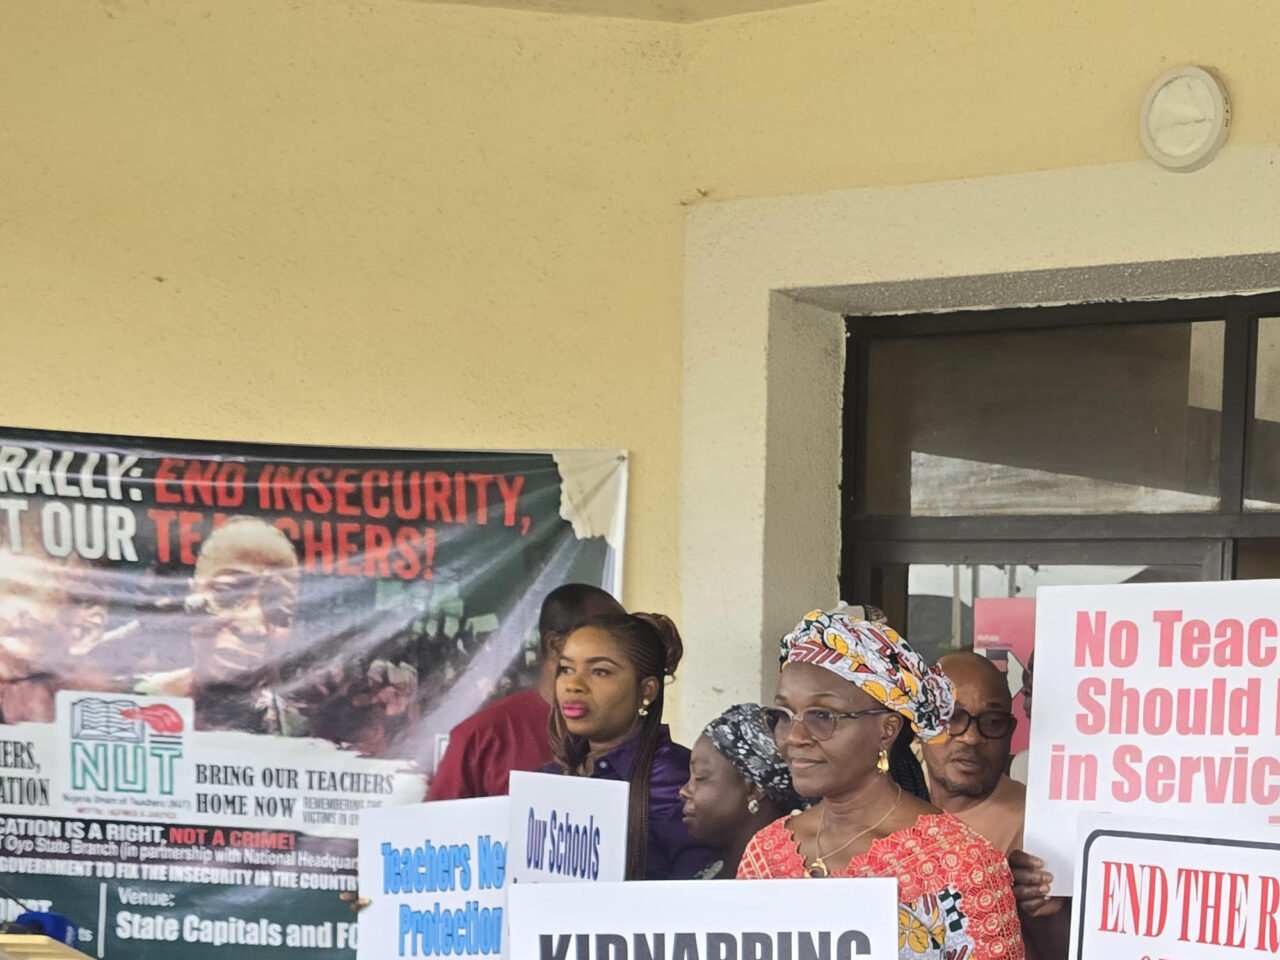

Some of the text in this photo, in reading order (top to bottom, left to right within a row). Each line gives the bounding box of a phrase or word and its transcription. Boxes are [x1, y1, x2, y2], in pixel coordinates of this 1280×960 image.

[0, 446, 531, 536] RALLY: END INSECURITY,
[41, 501, 139, 562] OUR
[148, 508, 436, 580] TEHERS!
[1074, 610, 1139, 668] No
[1076, 677, 1261, 736] Should
[71, 741, 183, 795] NUT
[195, 764, 394, 795] BRING OUR TEACHERS
[1049, 744, 1098, 801] in
[195, 792, 248, 816] HOME
[254, 796, 298, 818] NOW
[4, 835, 34, 855] Oyo
[35, 837, 70, 854] State
[71, 840, 119, 857] Branch
[139, 844, 212, 864] partnership
[215, 847, 242, 863] with
[244, 849, 295, 867] National
[298, 851, 358, 873] Headquar
[64, 821, 86, 839] IS
[87, 823, 103, 840] A
[106, 824, 168, 845] RIGHT,
[169, 827, 206, 845] NOT
[211, 829, 225, 846] A
[229, 830, 295, 850] CRIME!
[526, 806, 600, 881] Our Schools
[95, 862, 114, 878] TO
[116, 863, 139, 879] FIX
[141, 864, 167, 880] THE
[169, 866, 252, 886] INSECURITY
[255, 869, 270, 886] IN
[273, 871, 299, 888] THE
[300, 873, 358, 892] COUNTR
[381, 840, 471, 894] Teachers
[117, 886, 176, 907] Venue:
[1097, 861, 1168, 938] END
[1176, 868, 1249, 949] THE
[116, 910, 179, 942] State
[183, 914, 283, 946] Capitals
[286, 921, 334, 949] and
[399, 901, 504, 957] Protection
